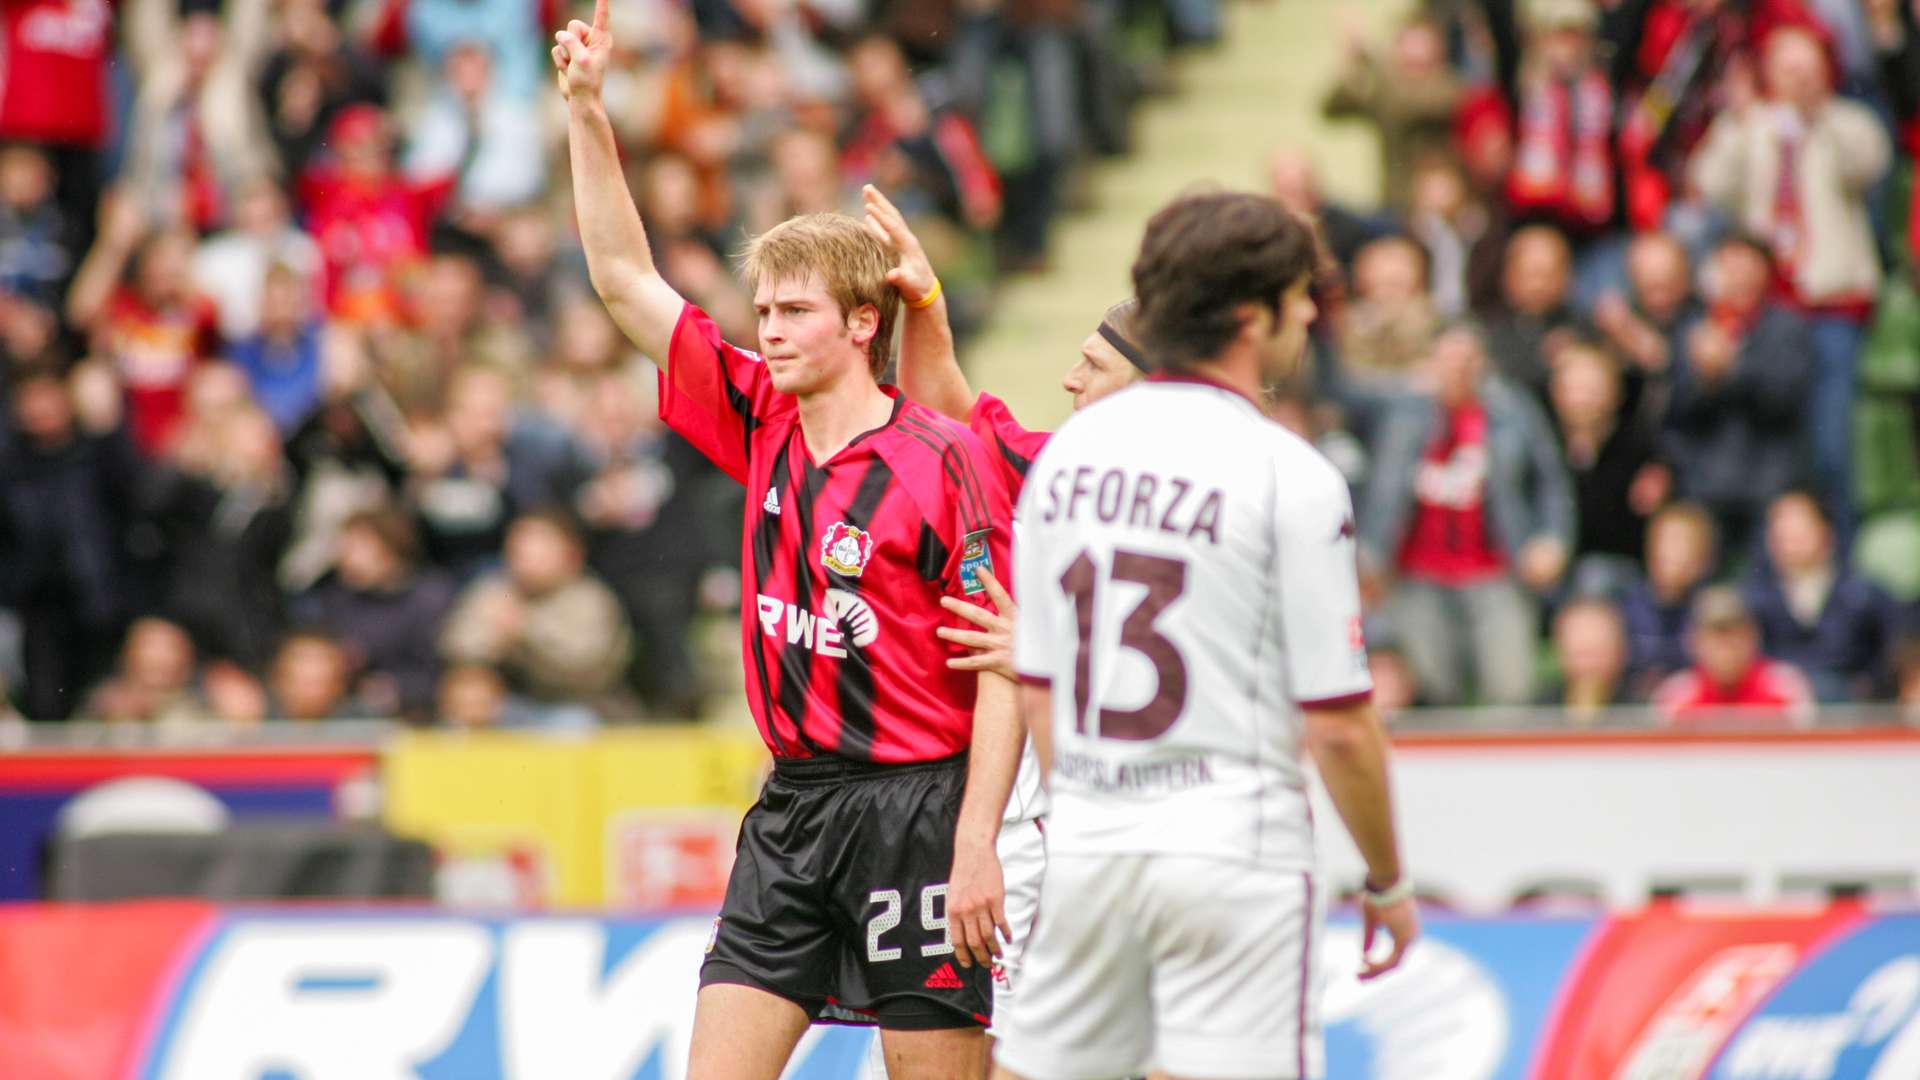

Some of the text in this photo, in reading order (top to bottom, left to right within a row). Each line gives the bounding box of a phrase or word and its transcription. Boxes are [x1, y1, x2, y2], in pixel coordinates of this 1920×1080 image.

[1044, 466, 1225, 545] SFORZA
[757, 594, 848, 658] RWE
[1059, 547, 1188, 741] 13
[867, 882, 955, 962] 29
